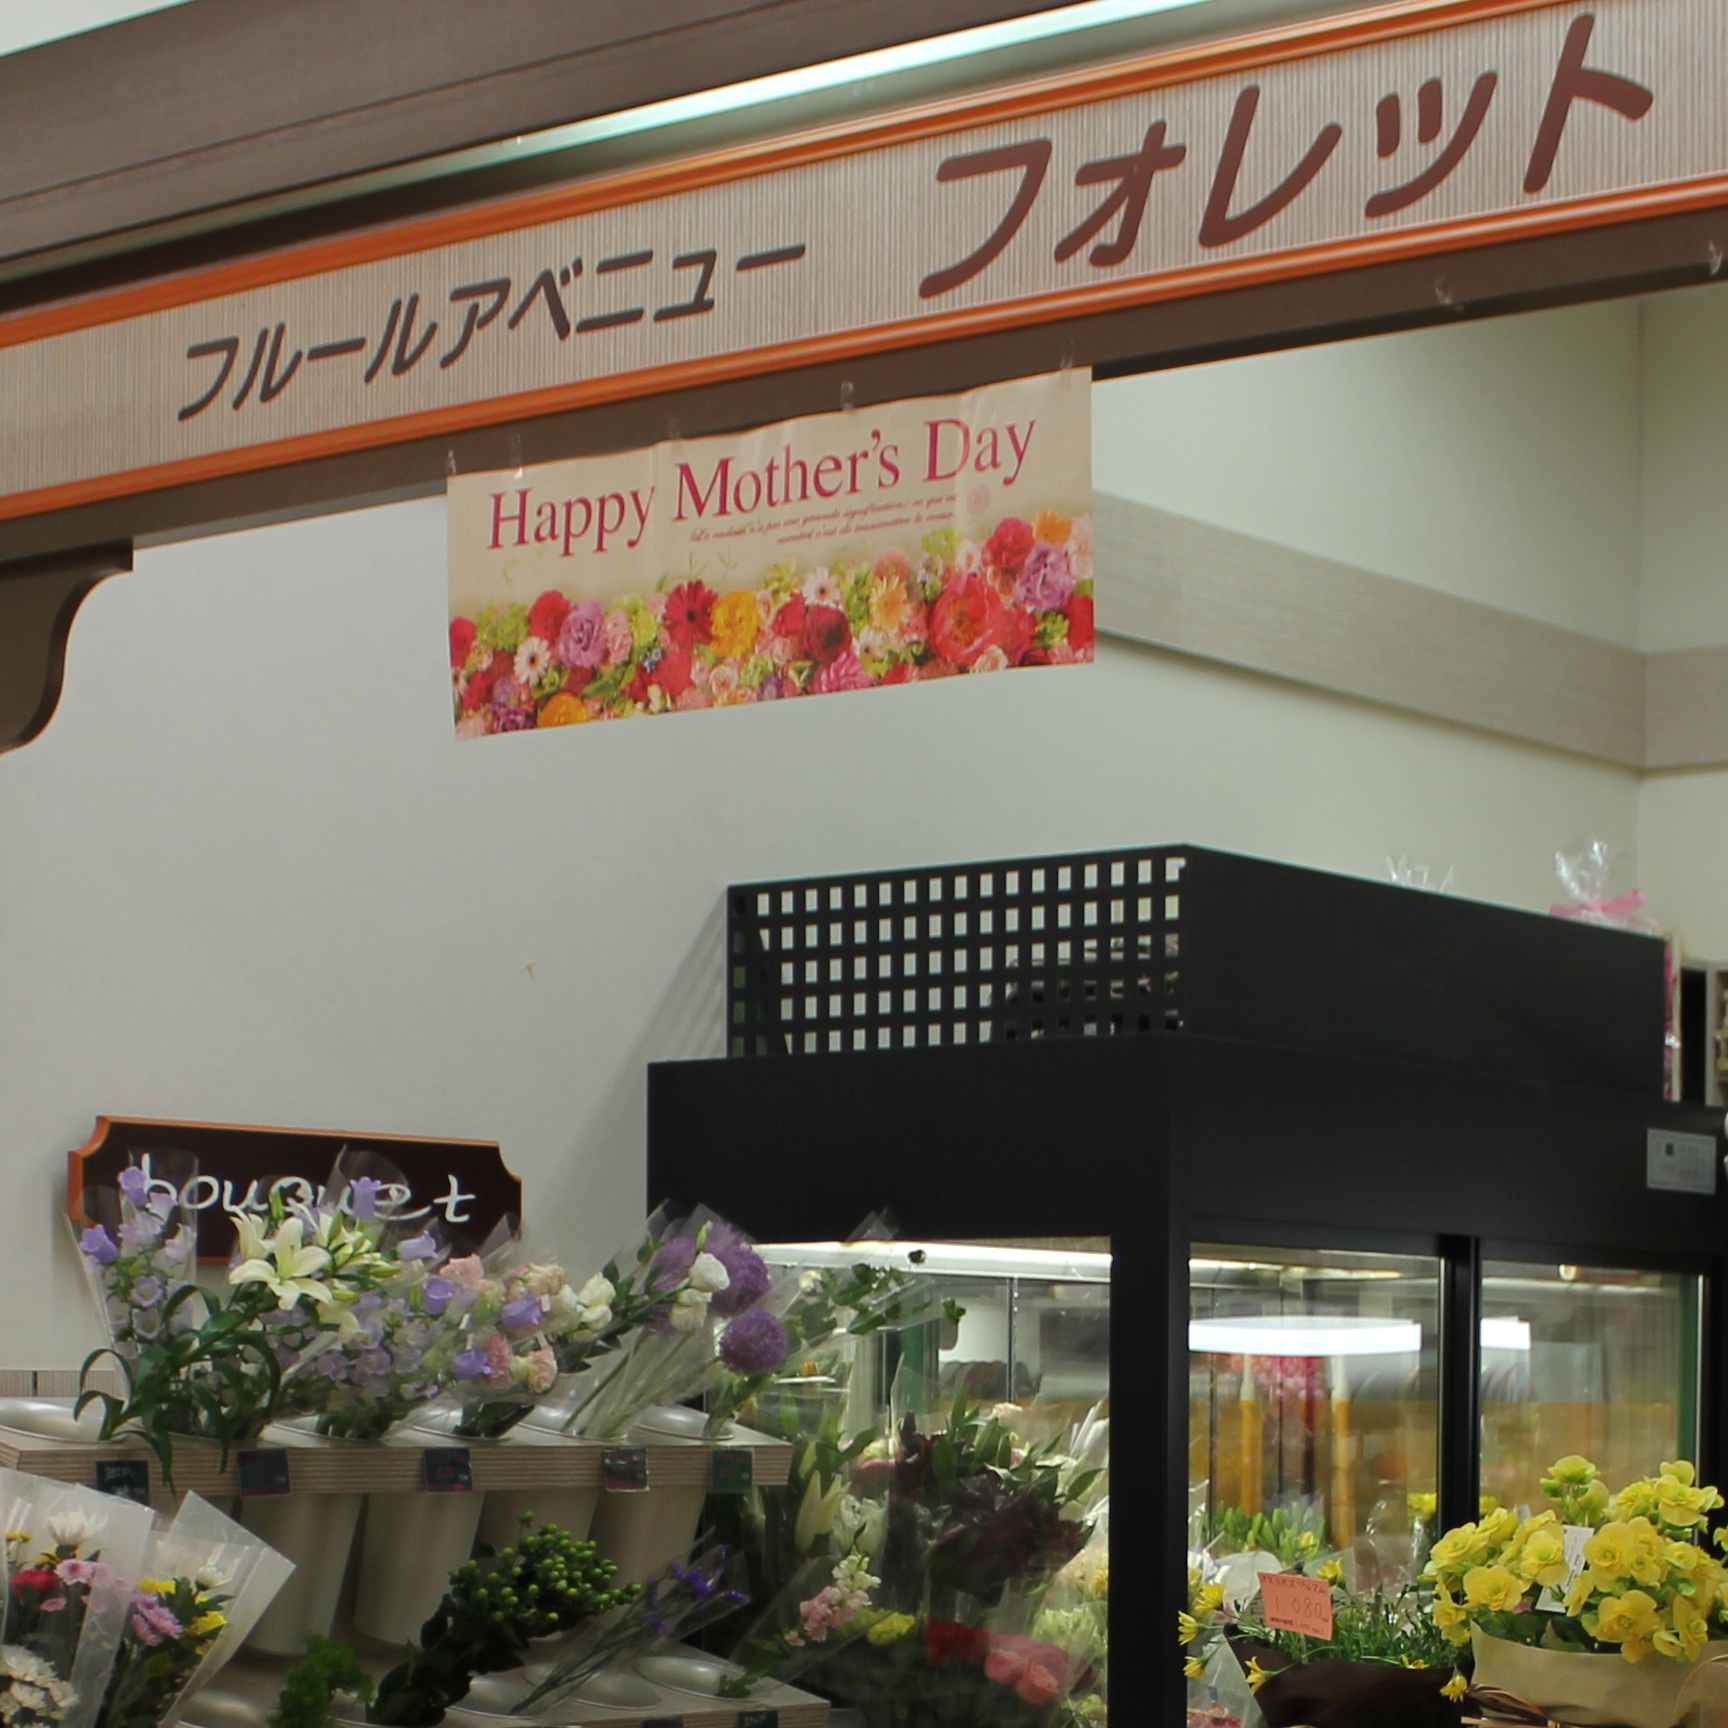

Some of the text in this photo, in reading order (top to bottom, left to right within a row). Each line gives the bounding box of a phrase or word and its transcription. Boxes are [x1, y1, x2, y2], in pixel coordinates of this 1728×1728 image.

[918, 15, 1653, 299] フォレット
[175, 239, 808, 426] フルールアベニュー
[486, 416, 1037, 557] Happy Mother's Day
